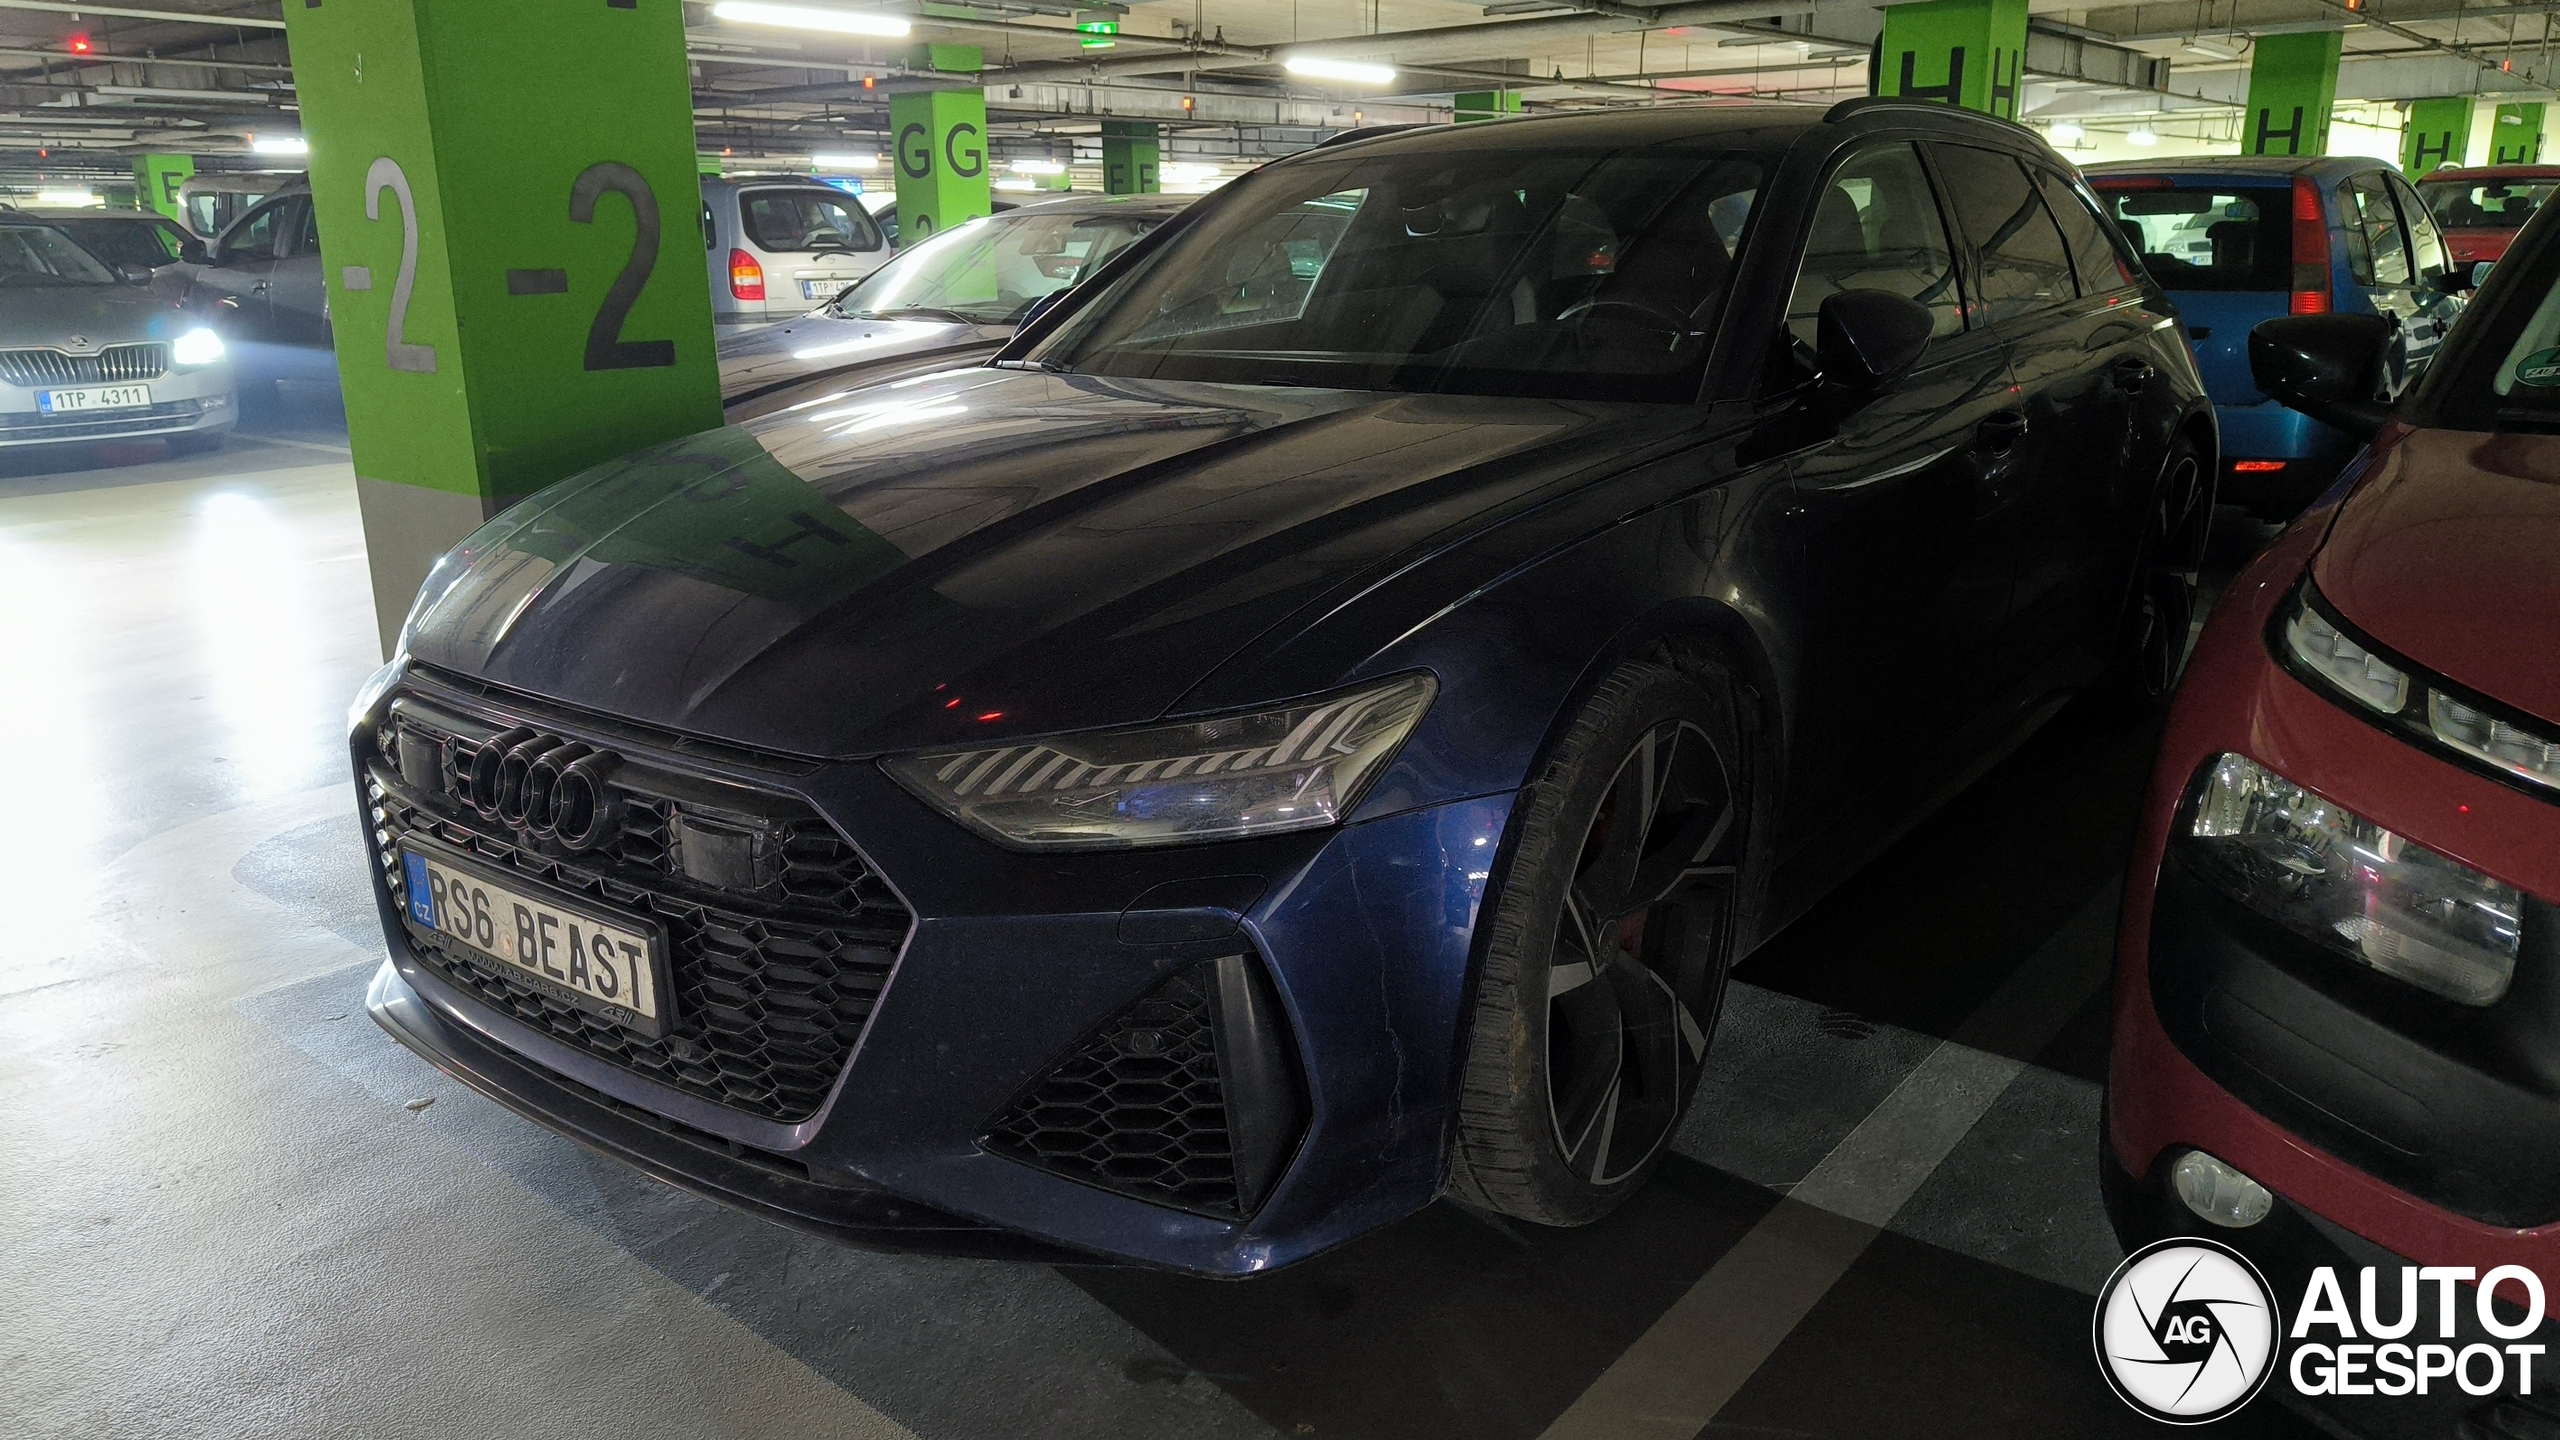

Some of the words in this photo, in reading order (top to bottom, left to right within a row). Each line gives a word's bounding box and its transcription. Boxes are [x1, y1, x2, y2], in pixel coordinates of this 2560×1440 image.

[1900, 46, 1965, 105] H
[1990, 46, 2018, 120] H
[898, 122, 931, 178] G
[946, 122, 982, 178] G
[2255, 106, 2303, 155] H
[2414, 131, 2451, 169] H
[161, 171, 184, 204] E
[341, 156, 437, 374] -2
[506, 161, 676, 372] -2
[813, 282, 829, 294] 1TP
[56, 392, 86, 409] 1TP
[101, 388, 141, 405] 4311
[414, 901, 431, 922] CZ
[427, 867, 494, 948] RS6
[512, 902, 644, 1010] BEAST
